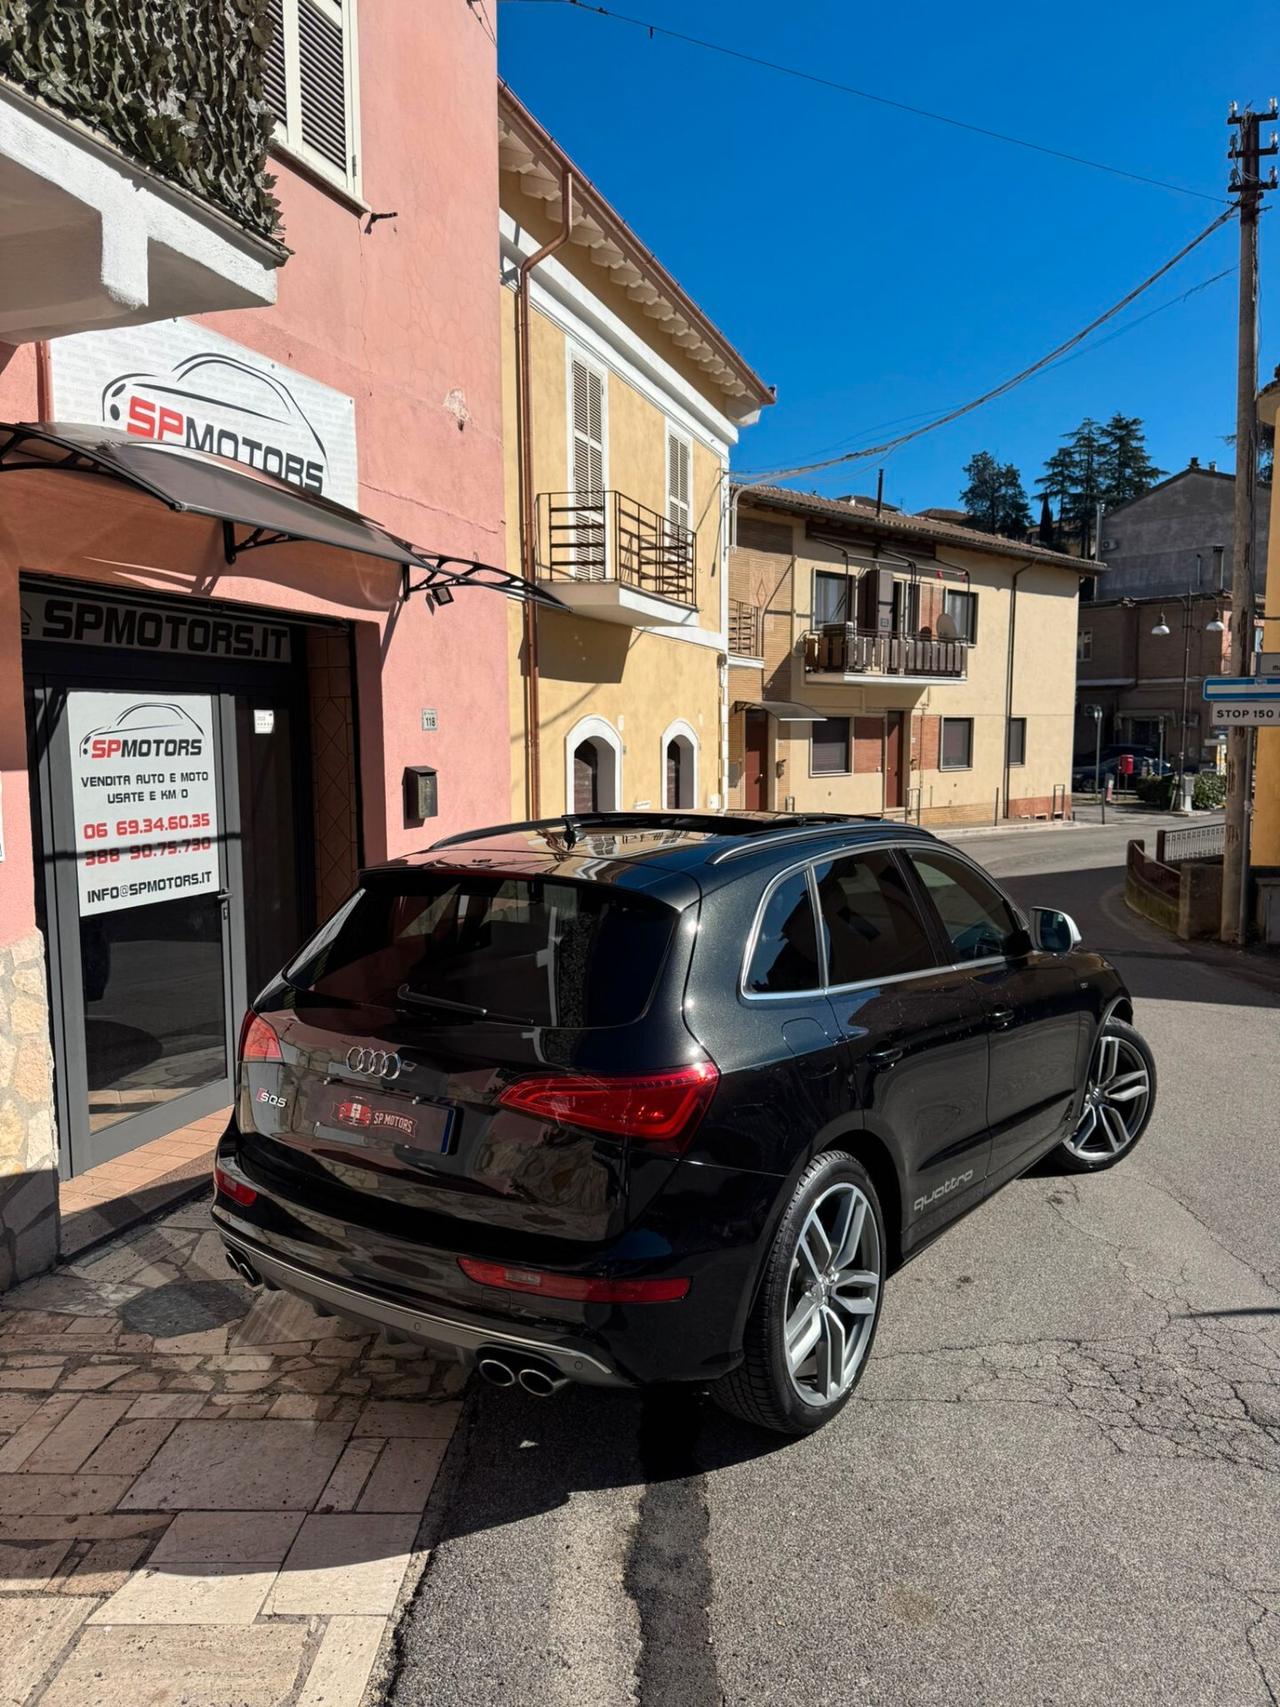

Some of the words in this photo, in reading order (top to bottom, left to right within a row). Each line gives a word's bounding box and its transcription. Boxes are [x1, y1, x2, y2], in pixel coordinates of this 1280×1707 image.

[127, 395, 324, 495] SPMOTORS
[42, 600, 288, 659] SPMOTORS.IT
[1216, 709, 1250, 718] STOP
[1253, 709, 1274, 718] 150
[91, 739, 202, 759] SPMOTORS
[81, 775, 131, 788] VENDITA
[136, 773, 165, 785] AUTO
[170, 773, 176, 783] E
[181, 771, 209, 782] MOTO
[107, 791, 145, 804] USATE
[149, 791, 156, 801] E
[161, 790, 177, 800] KM
[83, 822, 108, 840] 06
[116, 813, 210, 836] 69.34.60.35
[85, 848, 120, 866] 388
[87, 871, 212, 903] INFO@SPMOTORS.IT
[260, 1092, 287, 1108] SQ5
[373, 1112, 384, 1125] SP
[383, 1113, 413, 1133] MOTORS
[913, 1169, 974, 1211] quattro
